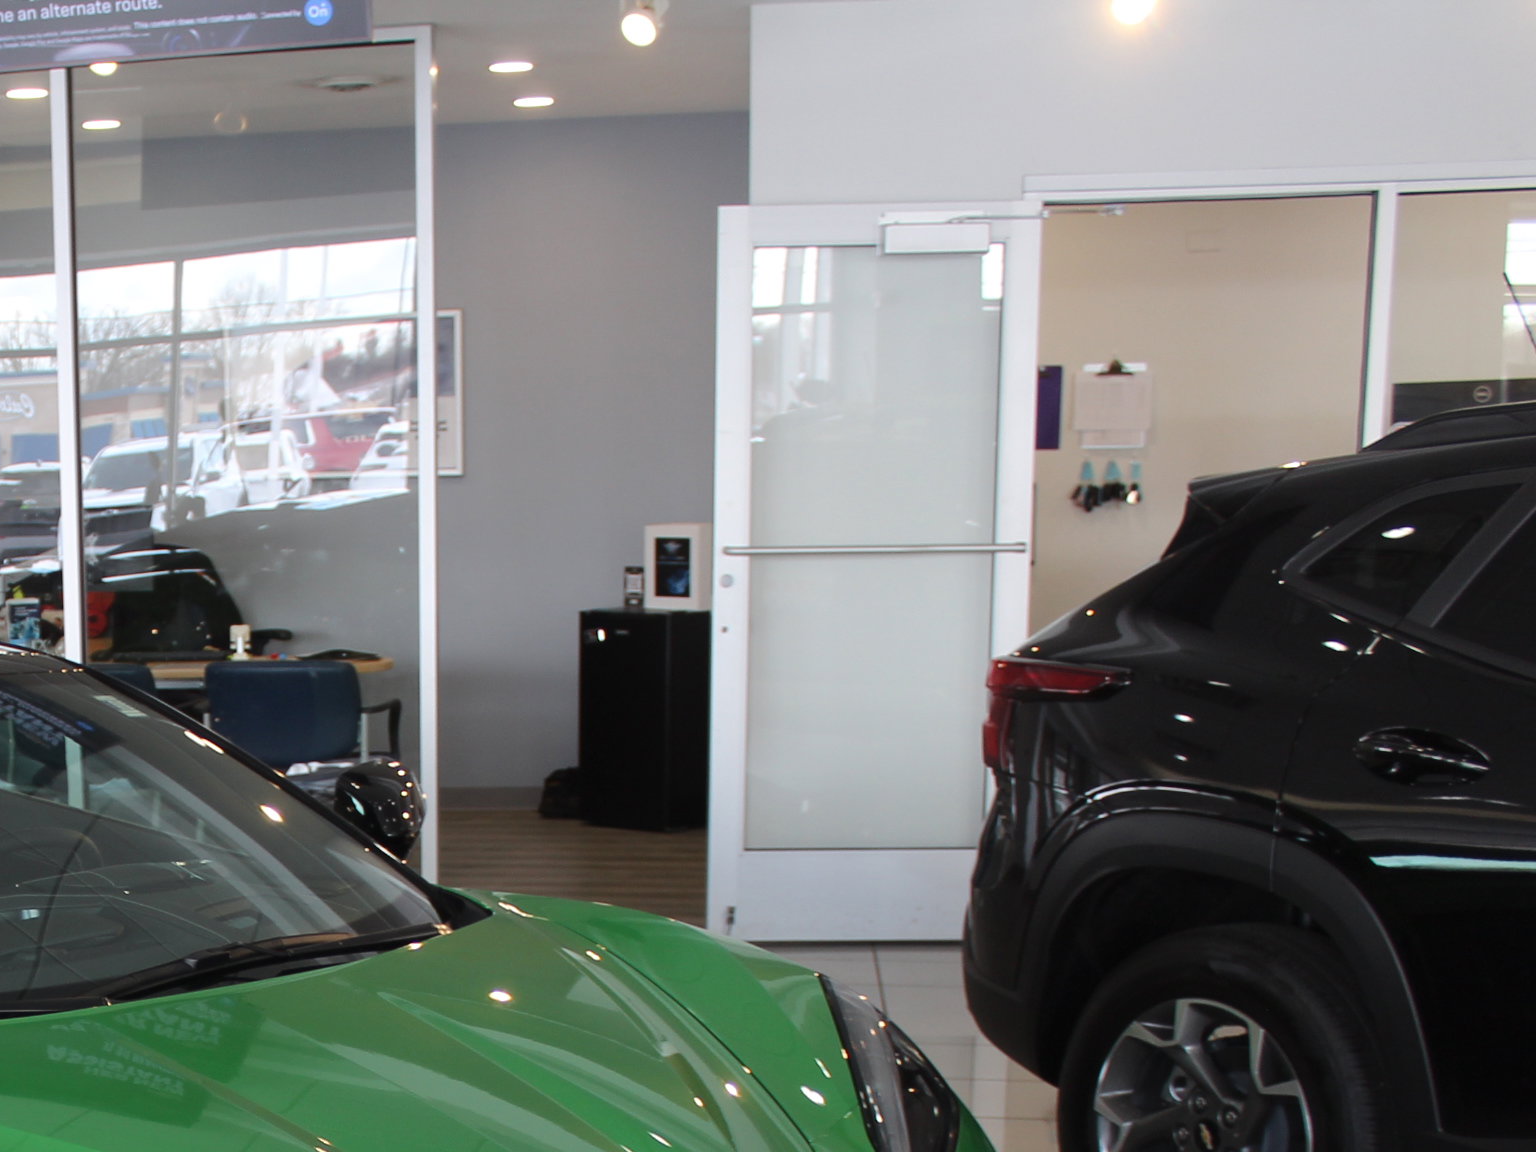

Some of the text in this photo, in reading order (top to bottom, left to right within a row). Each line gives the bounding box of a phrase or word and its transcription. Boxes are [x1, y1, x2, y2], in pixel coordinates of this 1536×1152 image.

[17, 8, 37, 21] an
[40, 3, 111, 19] alternate
[115, 0, 163, 12] route.
